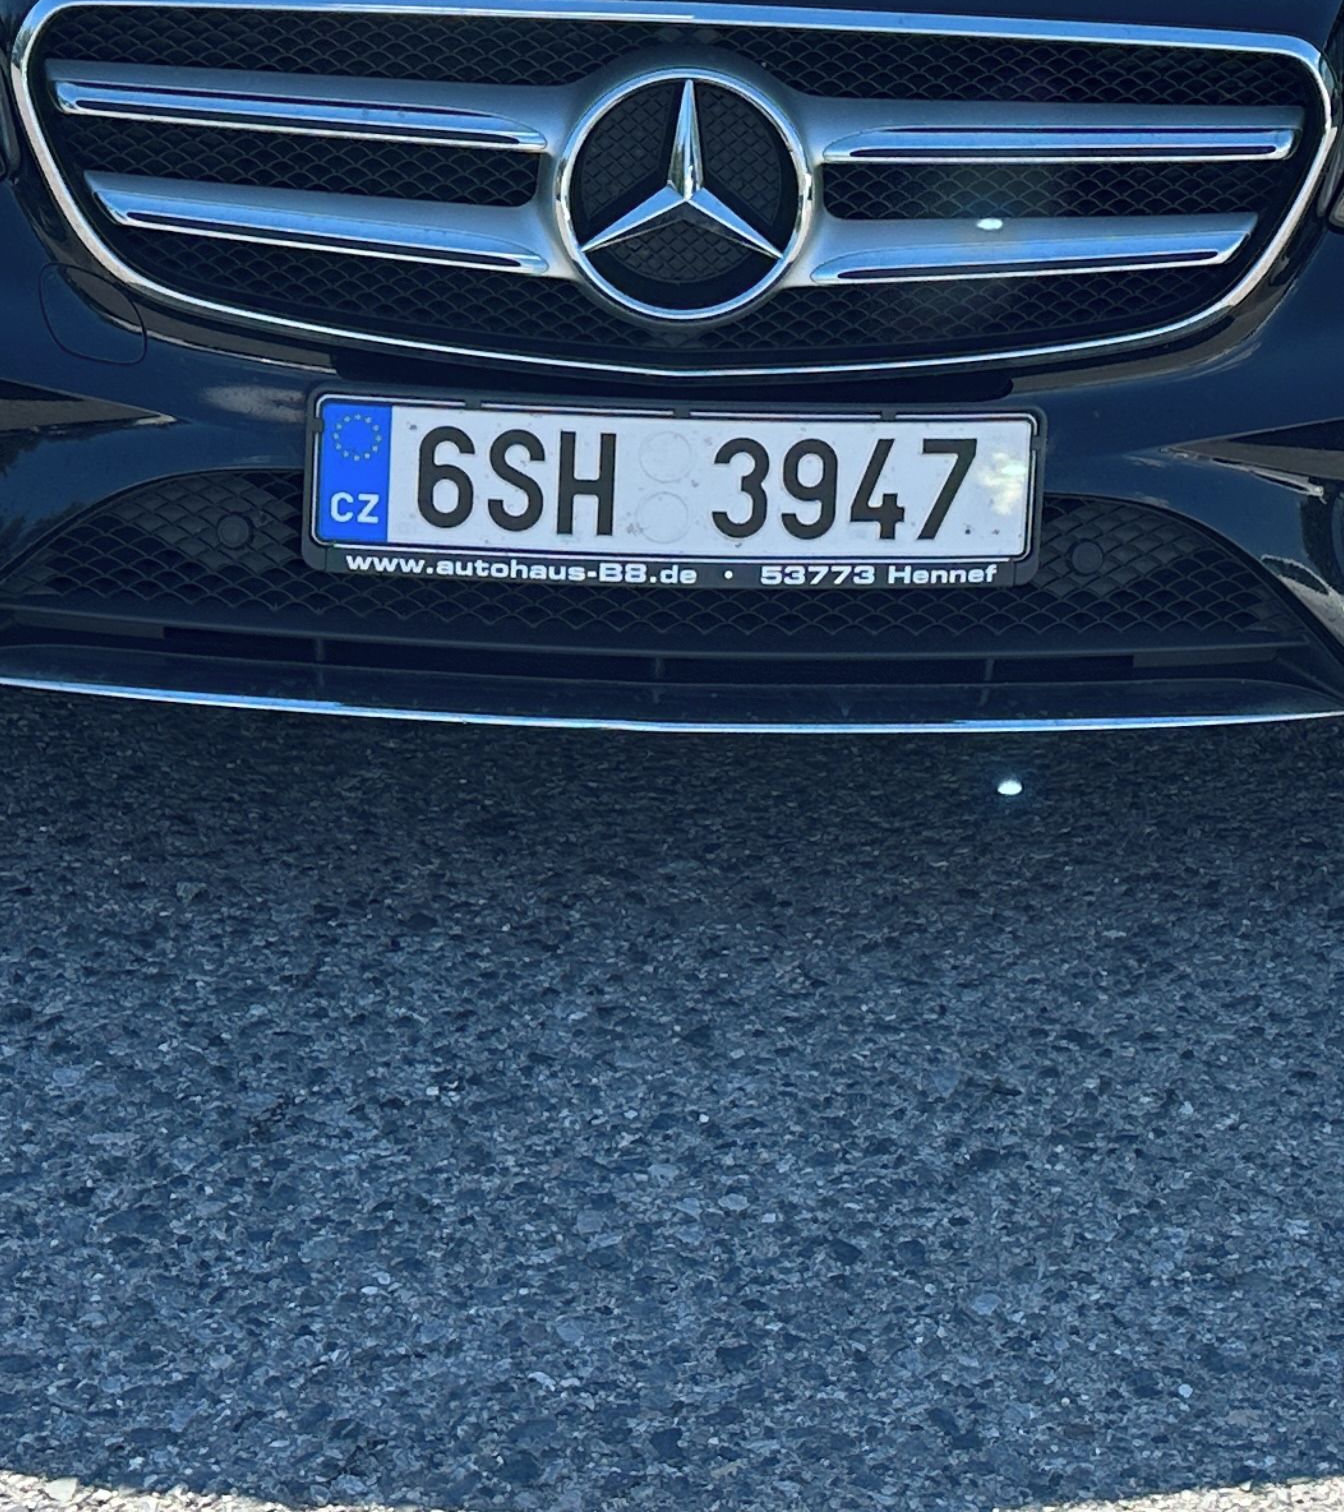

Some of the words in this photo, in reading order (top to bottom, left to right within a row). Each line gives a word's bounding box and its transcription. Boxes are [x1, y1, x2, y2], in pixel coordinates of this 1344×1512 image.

[330, 491, 380, 524] CZ
[417, 424, 617, 537] 6SH
[711, 436, 978, 540] 3947
[345, 553, 698, 586] www.autohaus-B8.de
[760, 564, 875, 586] 53773
[887, 563, 998, 585] Hennef
